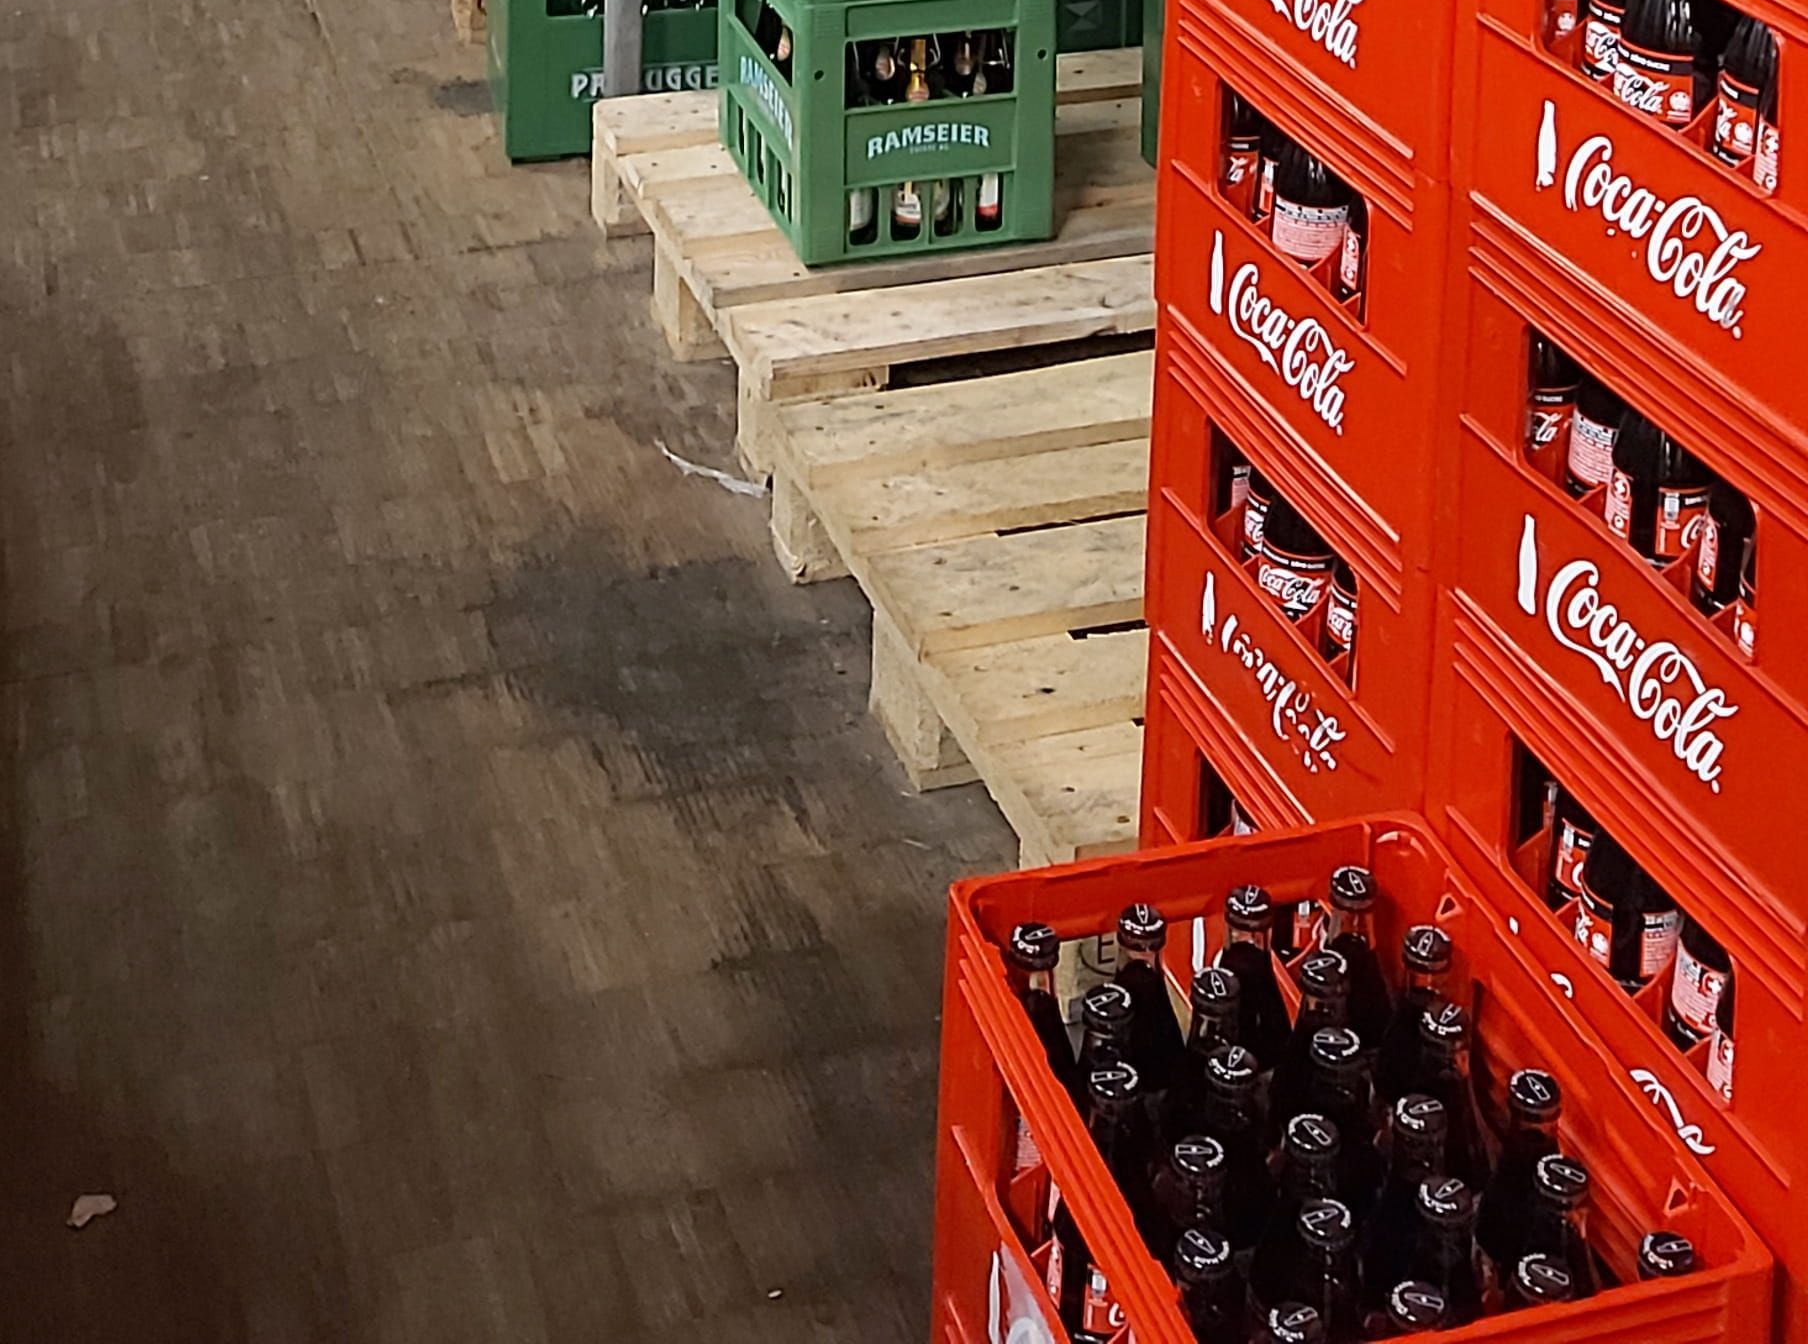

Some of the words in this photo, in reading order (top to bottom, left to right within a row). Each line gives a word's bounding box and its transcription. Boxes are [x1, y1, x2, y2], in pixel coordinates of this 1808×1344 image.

[739, 55, 794, 151] RAMSEIER
[866, 122, 991, 161] RAMSEIER
[1565, 134, 1762, 338] Coca-Cola
[1228, 264, 1355, 436] Coca-Cola
[1547, 560, 1739, 794] Coca-Cola
